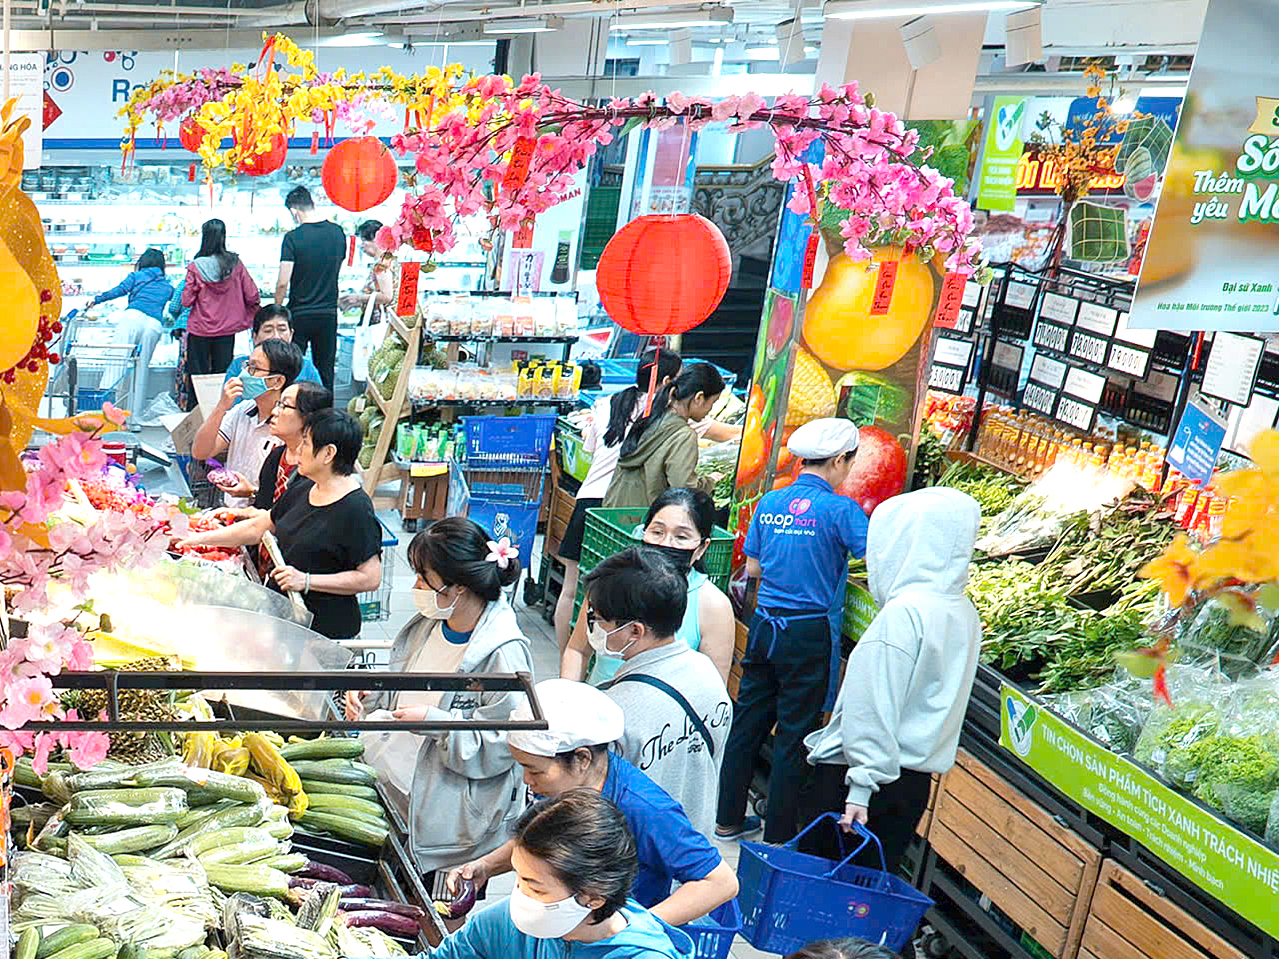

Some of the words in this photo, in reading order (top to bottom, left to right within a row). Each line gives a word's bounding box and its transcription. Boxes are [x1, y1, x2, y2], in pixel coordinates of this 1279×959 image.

[1193, 170, 1245, 194] Thêm
[1190, 196, 1229, 224] yêu
[1222, 282, 1236, 293] Đại
[1251, 283, 1273, 292] Xanh
[640, 723, 674, 771] The
[1108, 767, 1141, 800] PHẨM
[1168, 806, 1200, 840] XANH
[1202, 828, 1245, 871] TRÁCH
